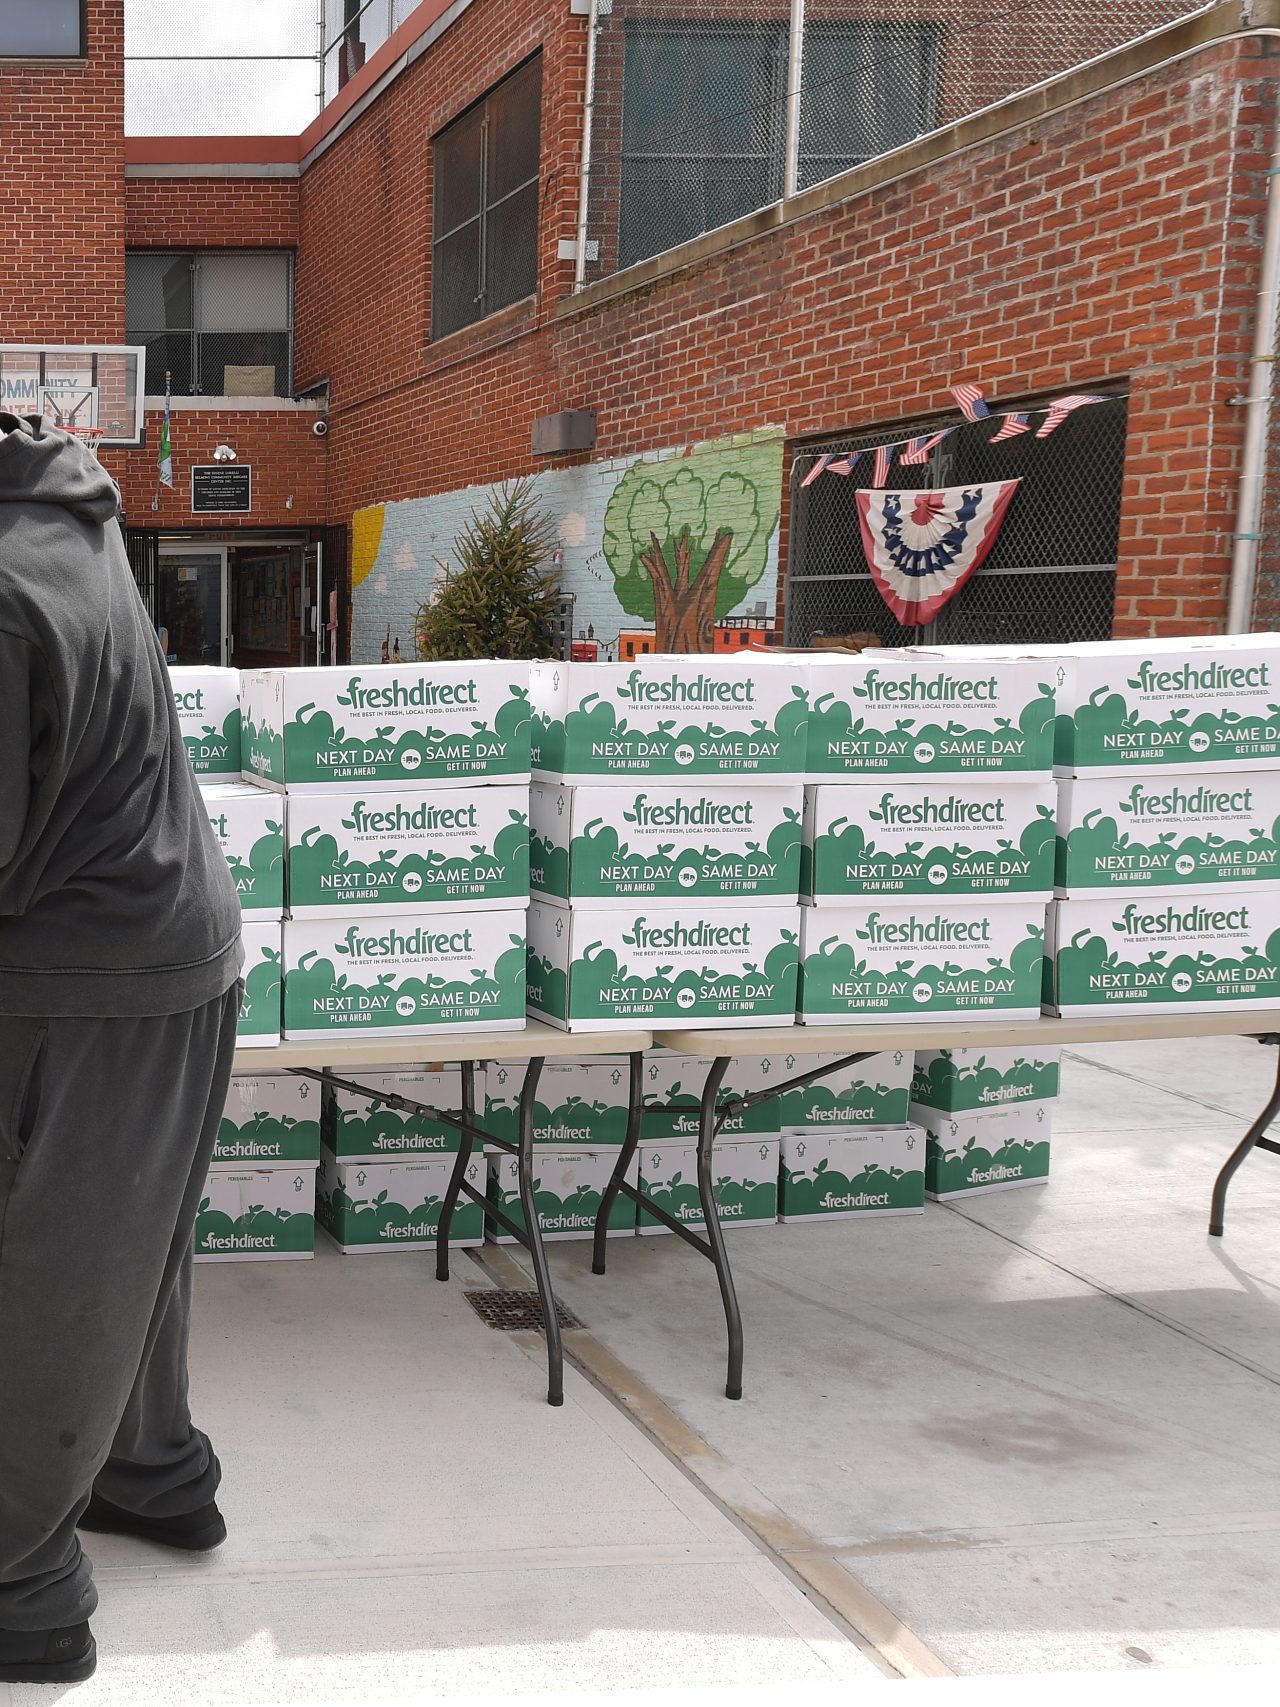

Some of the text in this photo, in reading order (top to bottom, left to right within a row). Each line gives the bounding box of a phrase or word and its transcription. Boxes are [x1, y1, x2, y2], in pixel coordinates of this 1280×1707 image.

[1137, 661, 1269, 692] freshdirect
[347, 677, 477, 709] freshdirect
[627, 669, 754, 701] freshdirect
[863, 669, 997, 701] freshdirect
[1104, 731, 1183, 748] NEXT DAY
[1215, 727, 1260, 742] SAME
[201, 746, 228, 757] DAY
[426, 743, 508, 759] SAME DAY
[592, 743, 670, 756] NEXT DAY
[700, 743, 780, 756] SAME DAY
[828, 742, 909, 754] NEXT DAY
[940, 741, 1025, 754] SAME DAY
[316, 749, 395, 765] NEXT DAY
[1129, 784, 1252, 815] freshdirect
[351, 801, 477, 832] freshdirect
[633, 794, 752, 825] freshdirect
[879, 793, 1004, 824] freshdirect
[1095, 854, 1170, 869] NEXT DAY
[1199, 850, 1277, 865] SAME DAY
[427, 866, 506, 882] SAME DAY
[600, 866, 674, 880] NEXT DAY
[702, 864, 777, 878] SAME DAY
[847, 864, 922, 878] NEXT DAY
[952, 861, 1031, 875] SAME DAY
[236, 878, 255, 891] AY
[321, 872, 397, 888] NEXT DAY
[616, 883, 655, 892] PLAN AHEAD
[734, 881, 740, 889] IT
[742, 881, 757, 889] NOW
[1122, 904, 1249, 934] freshdirect
[632, 917, 750, 948] freshdirect
[866, 912, 990, 943] freshdirect
[345, 926, 472, 957] freshdirect
[1090, 972, 1166, 988] NEXT DAY
[1197, 967, 1277, 983] SAME DAY
[700, 984, 774, 999] SAME DAY
[832, 982, 908, 996] NEXT DAY
[937, 979, 1015, 993] SAME DAY
[1232, 985, 1238, 993] IT
[1240, 984, 1256, 992] NOW
[421, 990, 501, 1006] SAME DAY
[600, 987, 672, 1002] NEXT DAY
[1106, 990, 1147, 999] PLAN AHEAD
[313, 995, 391, 1011] NEXT DAY
[982, 1083, 1033, 1103] freshdirect
[811, 1105, 874, 1121] freshdirect
[533, 1124, 591, 1139] eshdirect
[679, 1116, 744, 1132] fresect
[377, 1132, 446, 1149] freshdirect
[971, 1164, 1023, 1183] freshdirect
[825, 1192, 889, 1208] freshdirect
[680, 1203, 743, 1219] fresirect
[385, 1221, 438, 1239] freshdire
[207, 1232, 276, 1249] freshdirect
[55, 1637, 73, 1648] UGG
